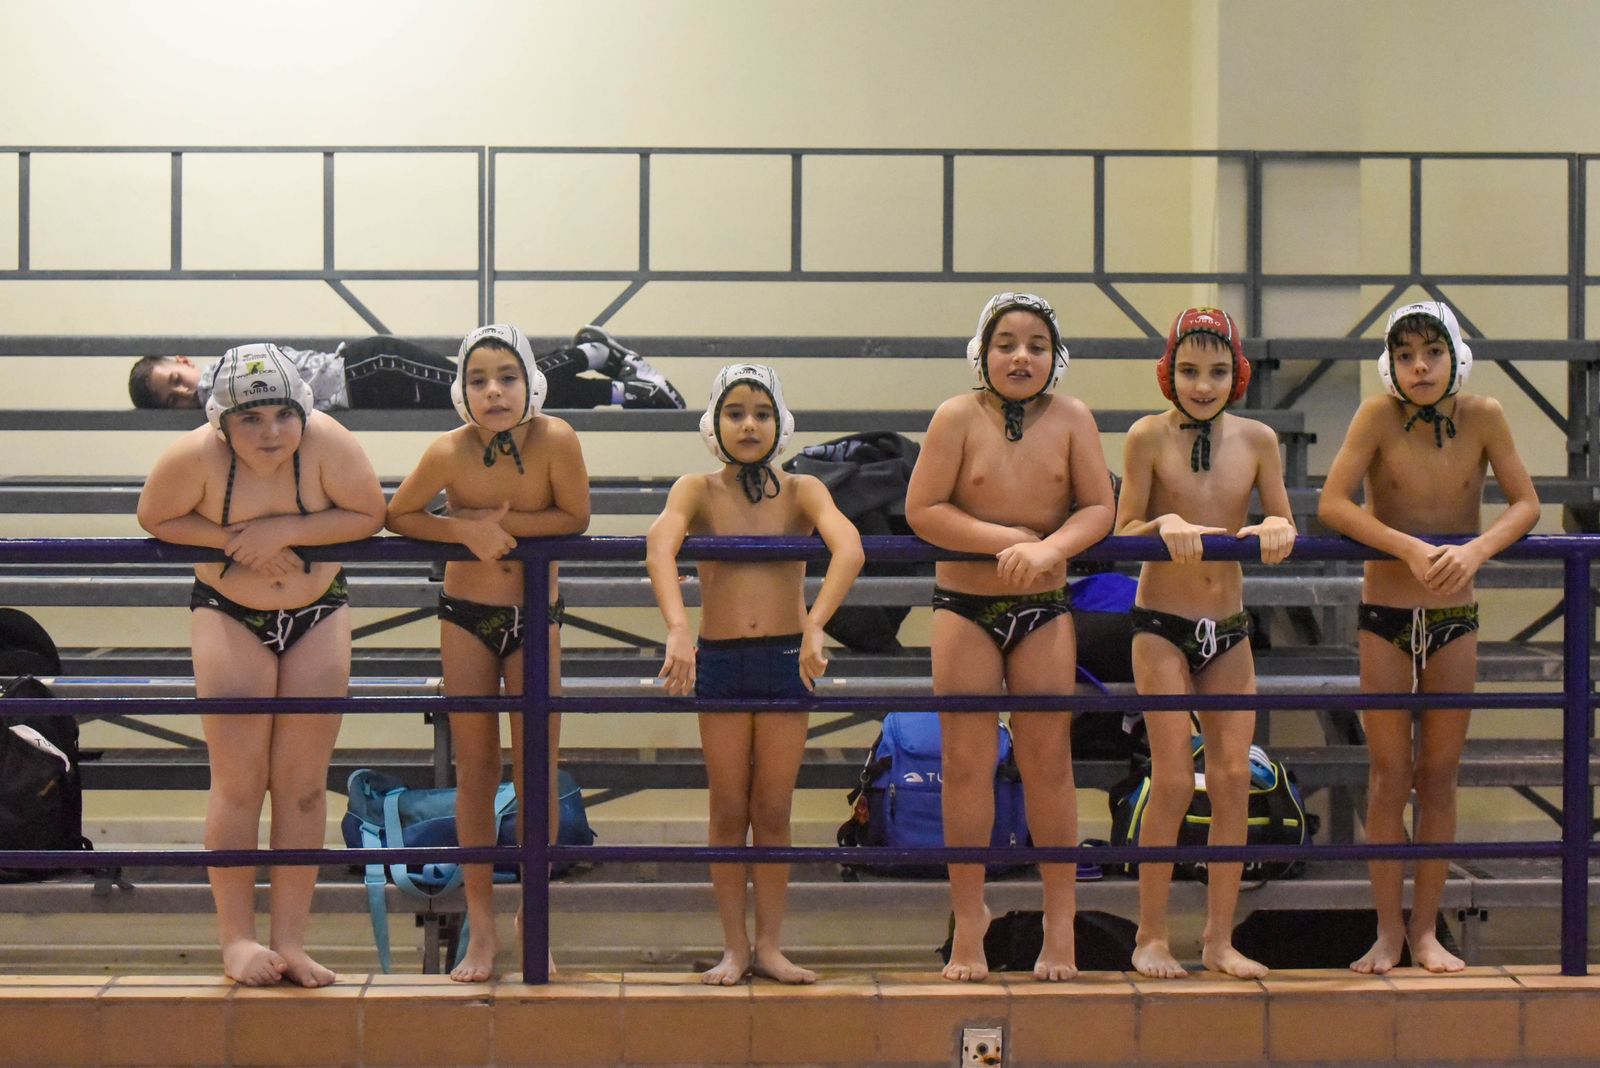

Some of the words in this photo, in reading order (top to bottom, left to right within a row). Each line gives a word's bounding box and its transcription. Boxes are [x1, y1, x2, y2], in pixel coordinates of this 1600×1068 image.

[1190, 319, 1220, 327] TURBO
[734, 370, 764, 378] TURBO
[243, 386, 277, 396] TURBO
[926, 772, 943, 783] TU
